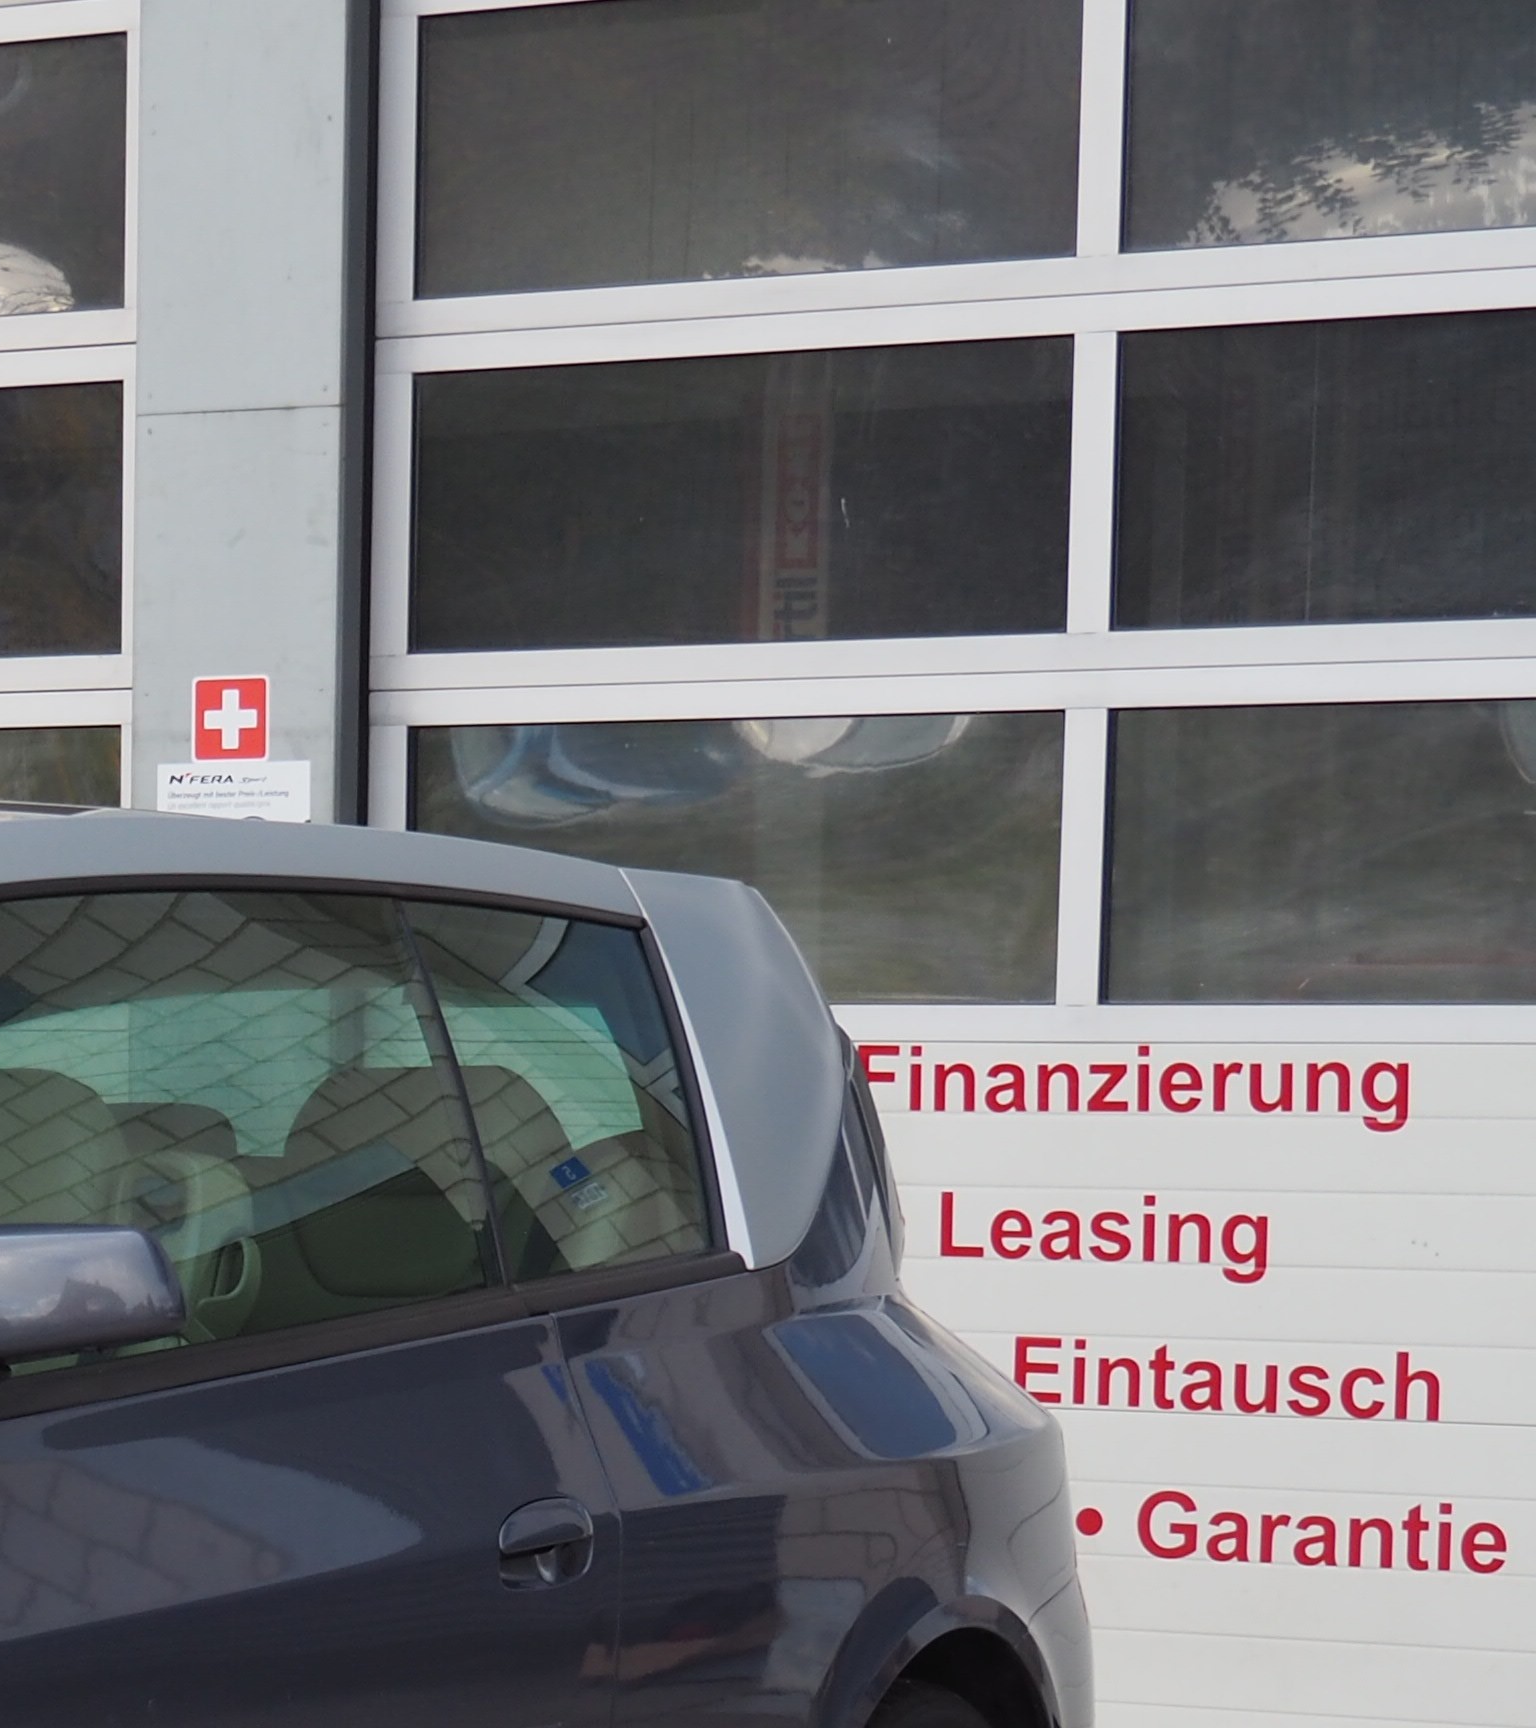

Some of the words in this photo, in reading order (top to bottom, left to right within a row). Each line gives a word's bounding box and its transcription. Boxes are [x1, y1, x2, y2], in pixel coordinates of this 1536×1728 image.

[856, 1045, 1411, 1133] Finanzierung
[939, 1191, 1270, 1284] Leasing
[1013, 1335, 1441, 1423] Eintausch
[1137, 1490, 1508, 1574] Garantie
